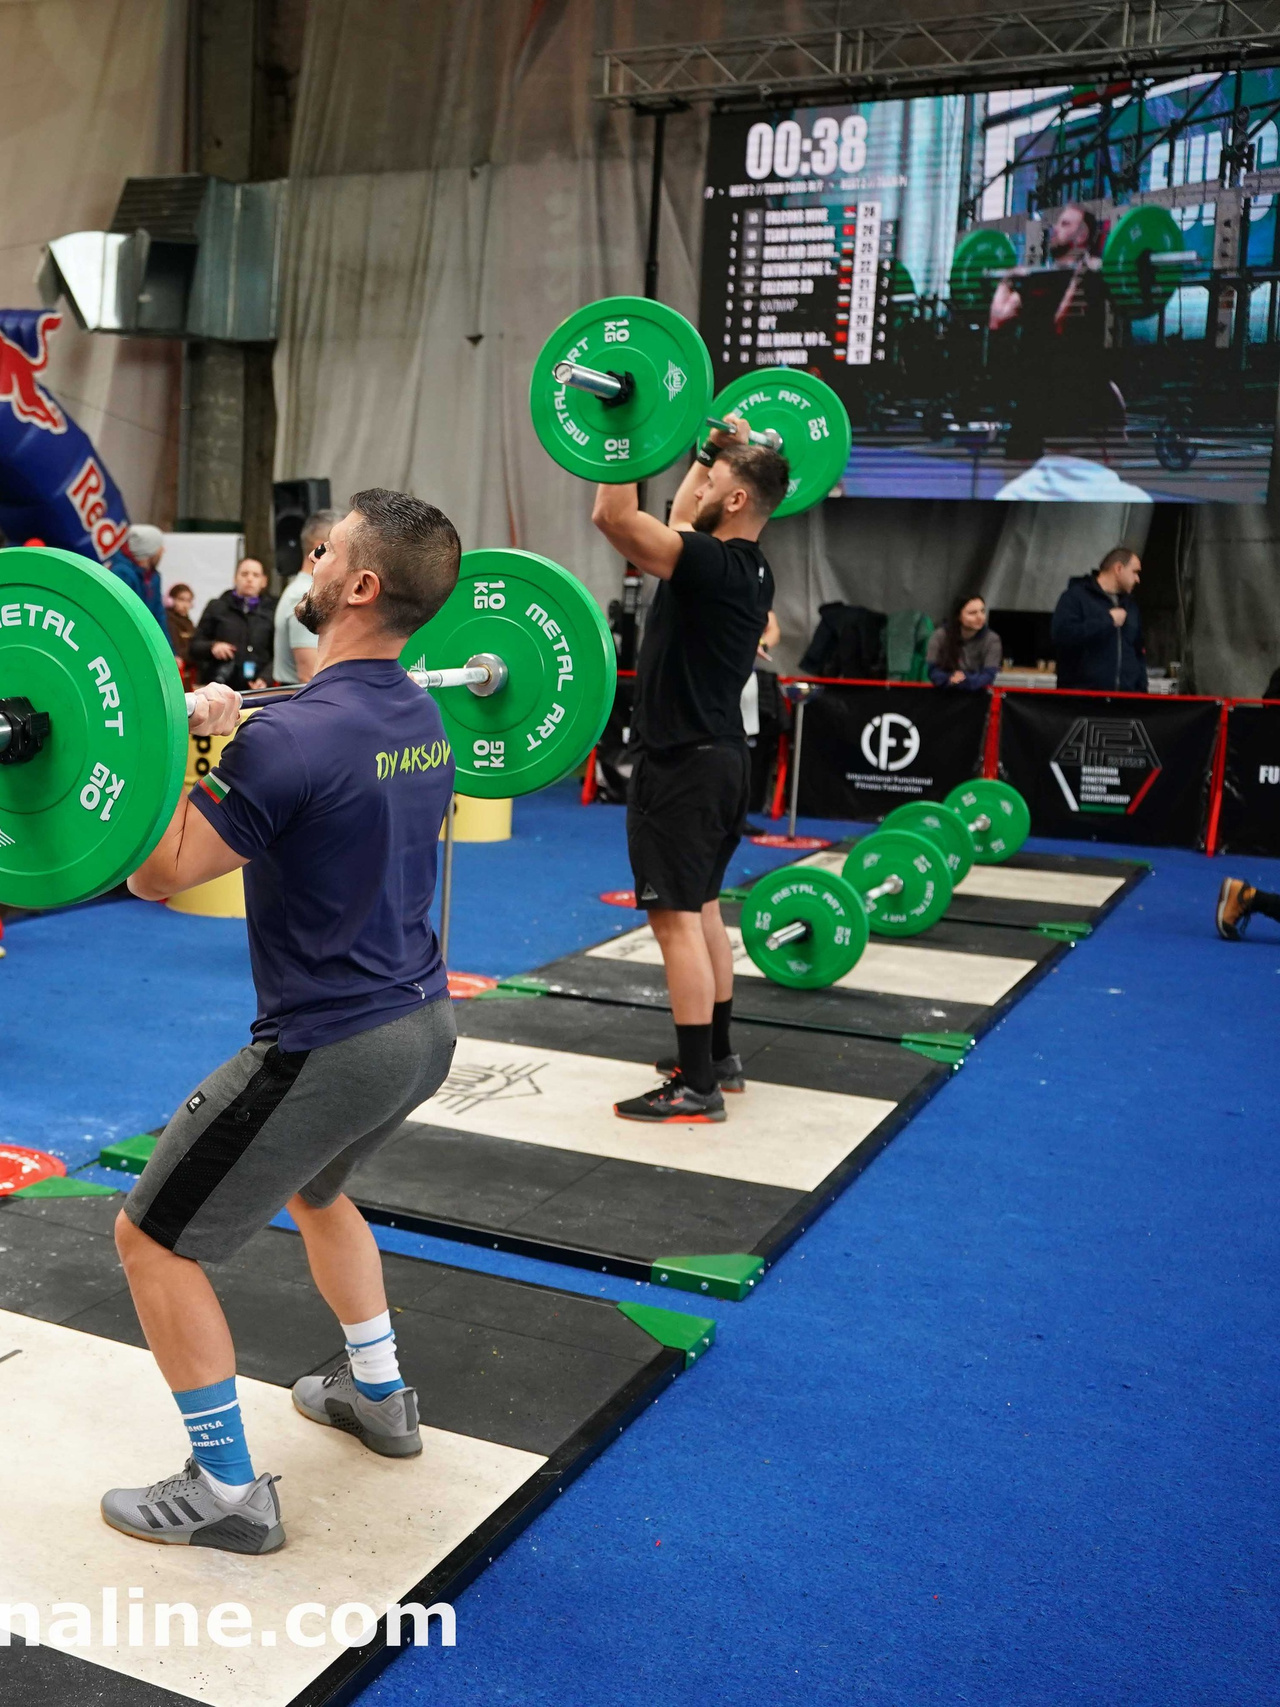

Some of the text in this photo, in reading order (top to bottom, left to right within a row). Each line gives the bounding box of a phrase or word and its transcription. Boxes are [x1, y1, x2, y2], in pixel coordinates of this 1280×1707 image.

[746, 115, 868, 180] 00:38
[604, 321, 617, 343] KG
[616, 319, 630, 343] 10
[554, 337, 590, 446] METAL RT
[732, 389, 811, 418] ETAL ART
[604, 438, 618, 461] 10
[618, 438, 630, 460] KG
[69, 461, 129, 558] Red
[474, 582, 488, 609] KG
[488, 580, 506, 610] 10
[525, 603, 573, 751] METAL ART
[87, 656, 124, 737] ART
[473, 739, 490, 769] 10
[490, 740, 505, 768] KG
[89, 762, 125, 800] KG
[1259, 765, 1280, 784] FU
[80, 783, 115, 821] 10
[771, 883, 818, 905] METAL
[822, 892, 845, 917] ART
[188, 1420, 224, 1433] ANITSA
